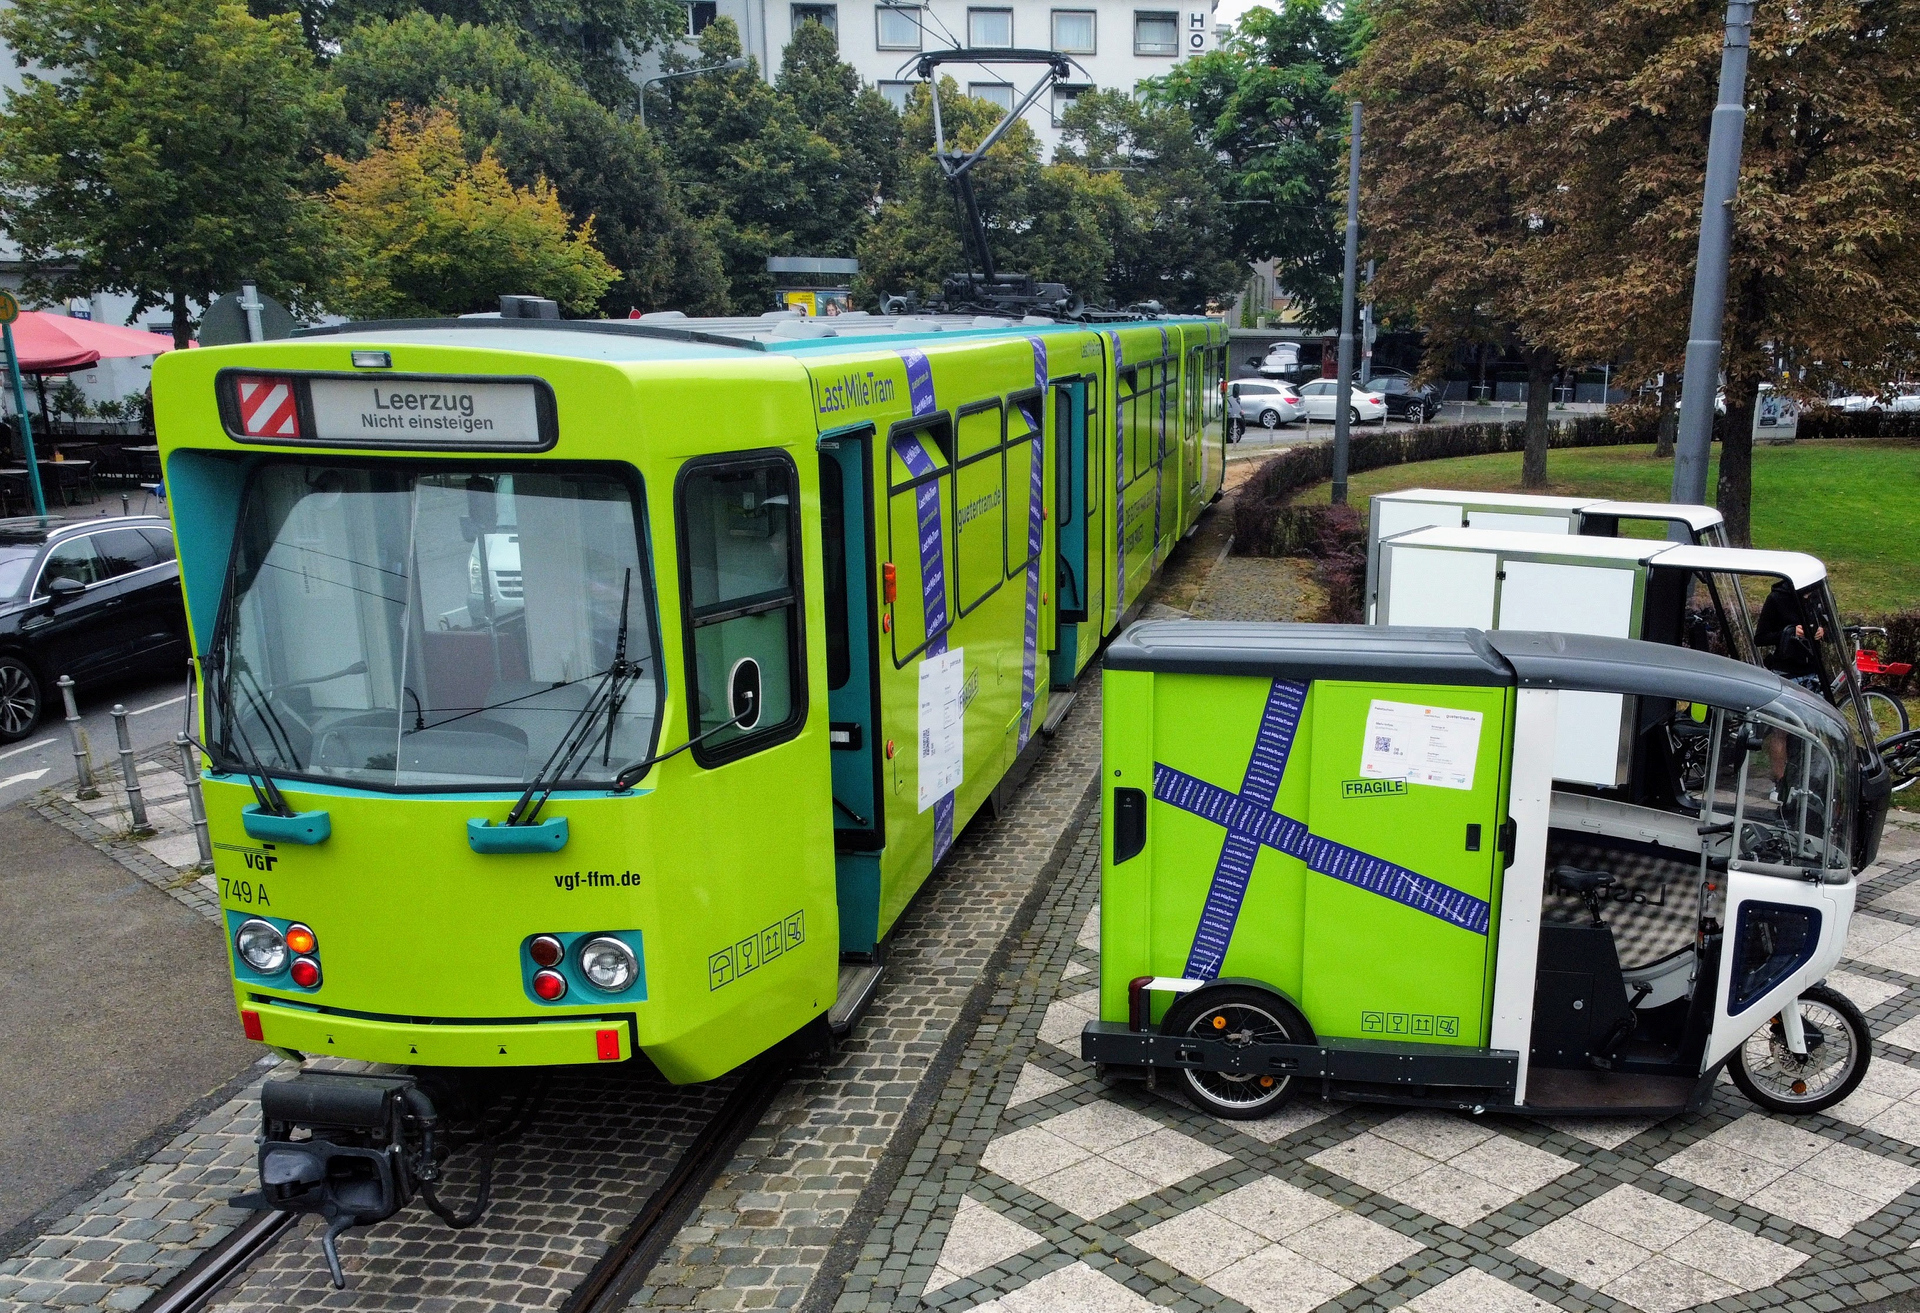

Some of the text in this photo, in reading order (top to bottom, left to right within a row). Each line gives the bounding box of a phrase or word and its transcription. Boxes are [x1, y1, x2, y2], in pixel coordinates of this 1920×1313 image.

[1190, 13, 1204, 56] HO
[374, 388, 474, 417] Leerzug
[361, 414, 494, 434] Nicht einsteigen
[1346, 780, 1404, 795] FRAGILE
[244, 847, 278, 872] VGF
[221, 877, 270, 906] 749 A
[554, 870, 641, 891] vgf-ffm.de
